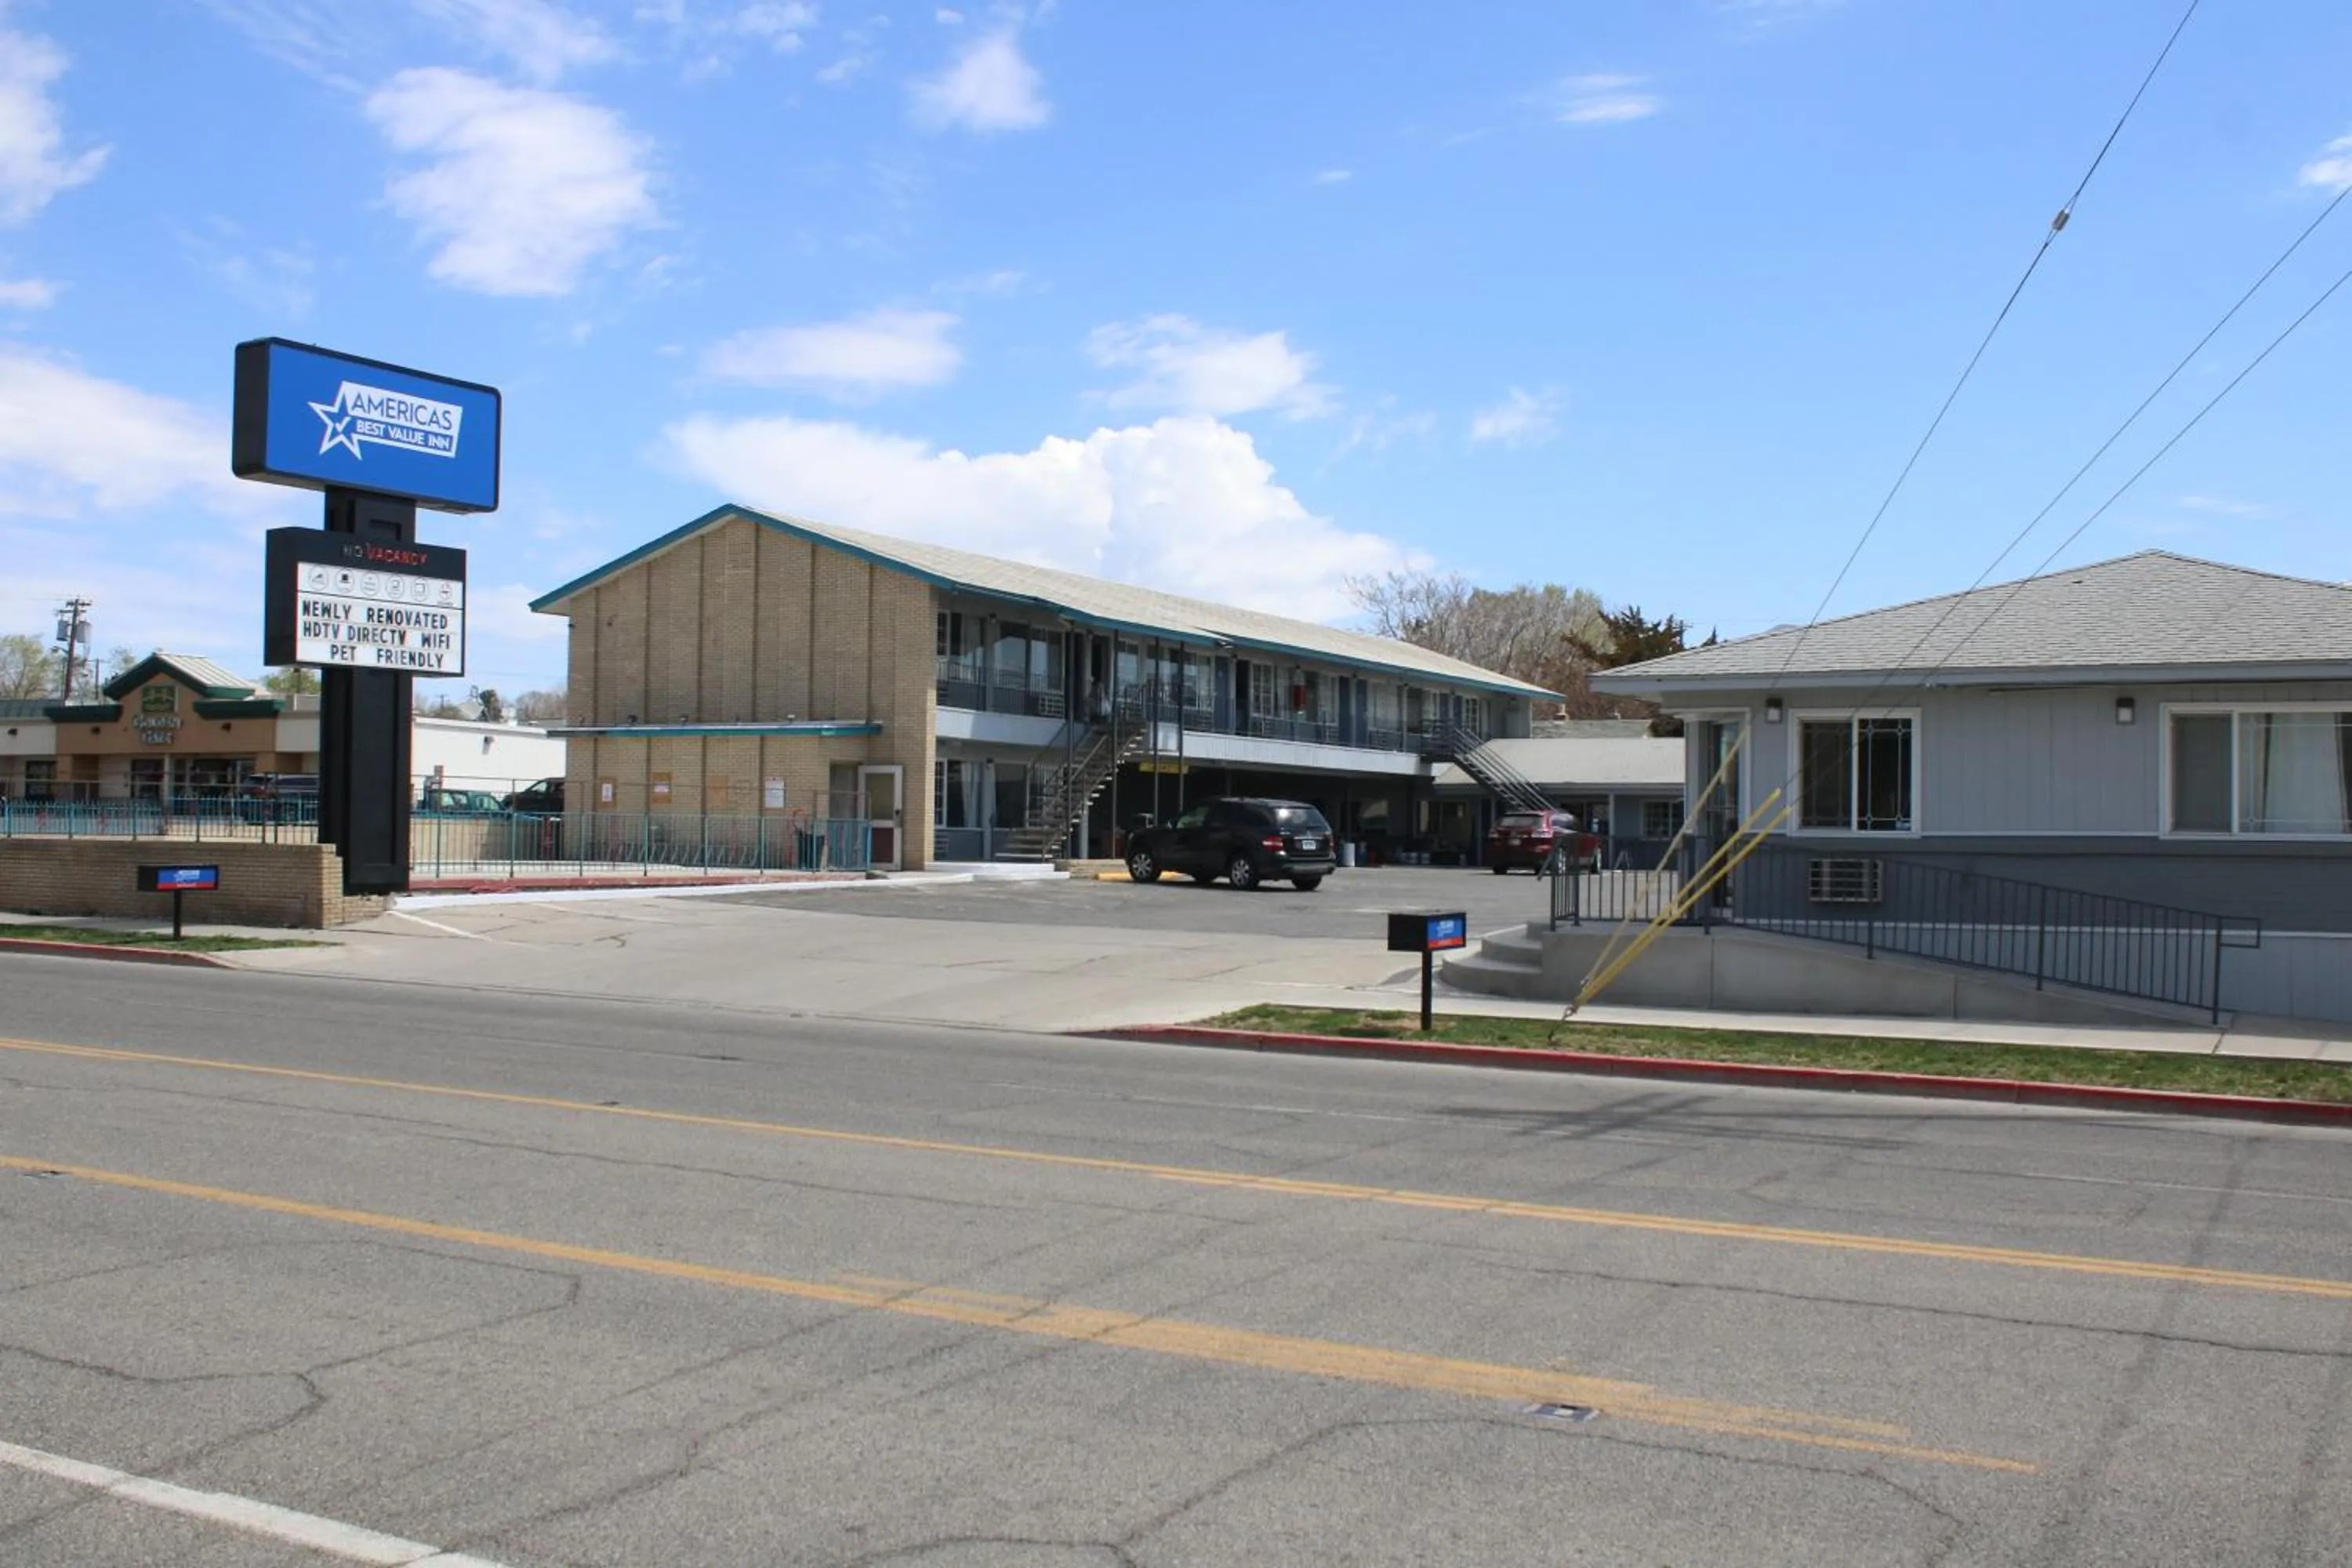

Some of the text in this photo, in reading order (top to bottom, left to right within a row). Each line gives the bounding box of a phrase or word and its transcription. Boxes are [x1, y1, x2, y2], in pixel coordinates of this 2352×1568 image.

[352, 392, 452, 430] AMERICAS
[356, 420, 449, 450] BEST VALUE INN
[343, 543, 427, 565] NO VACANCY
[302, 600, 448, 629] NEWLY RENOVATED
[303, 622, 450, 649] HDTV DIRECTV WIFI
[331, 644, 444, 668] PET FRIENDLY
